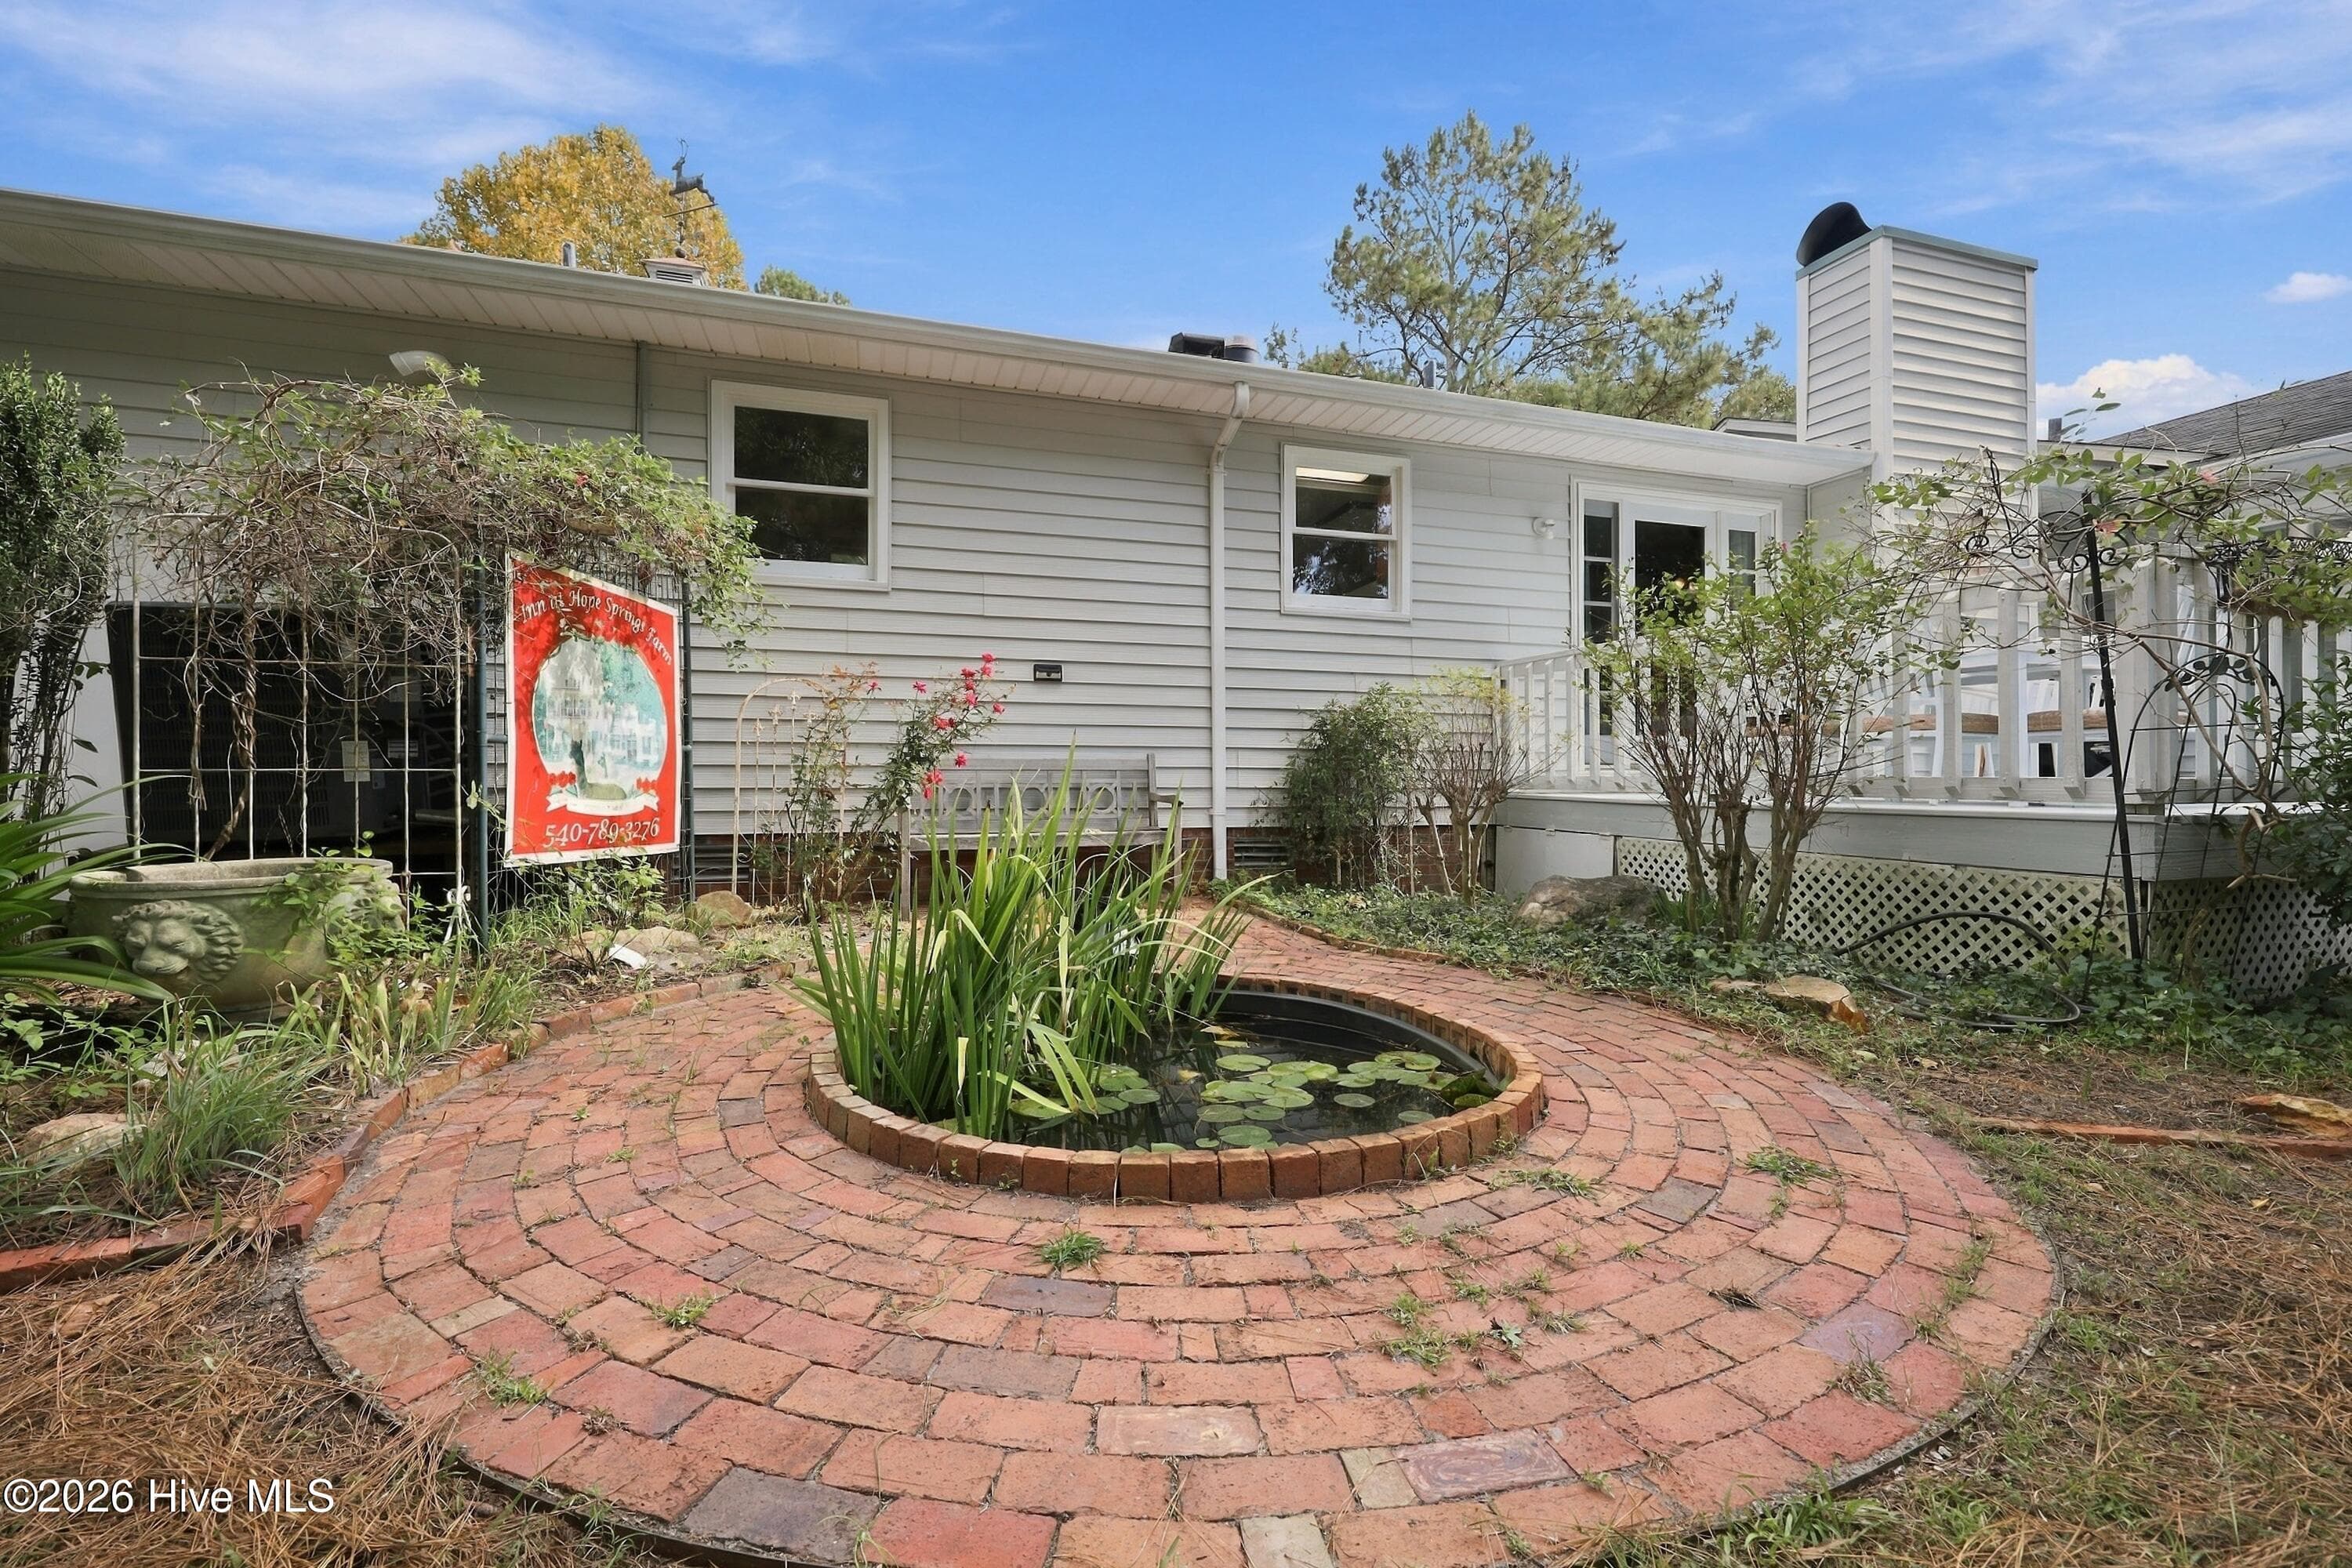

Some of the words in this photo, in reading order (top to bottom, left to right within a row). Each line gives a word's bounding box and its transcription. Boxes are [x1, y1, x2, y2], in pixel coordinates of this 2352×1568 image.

[521, 600, 546, 624] Inn
[568, 587, 601, 613] Hope
[605, 597, 646, 633] Springs
[644, 626, 673, 666] Farm
[543, 817, 660, 848] 540-789-3276
